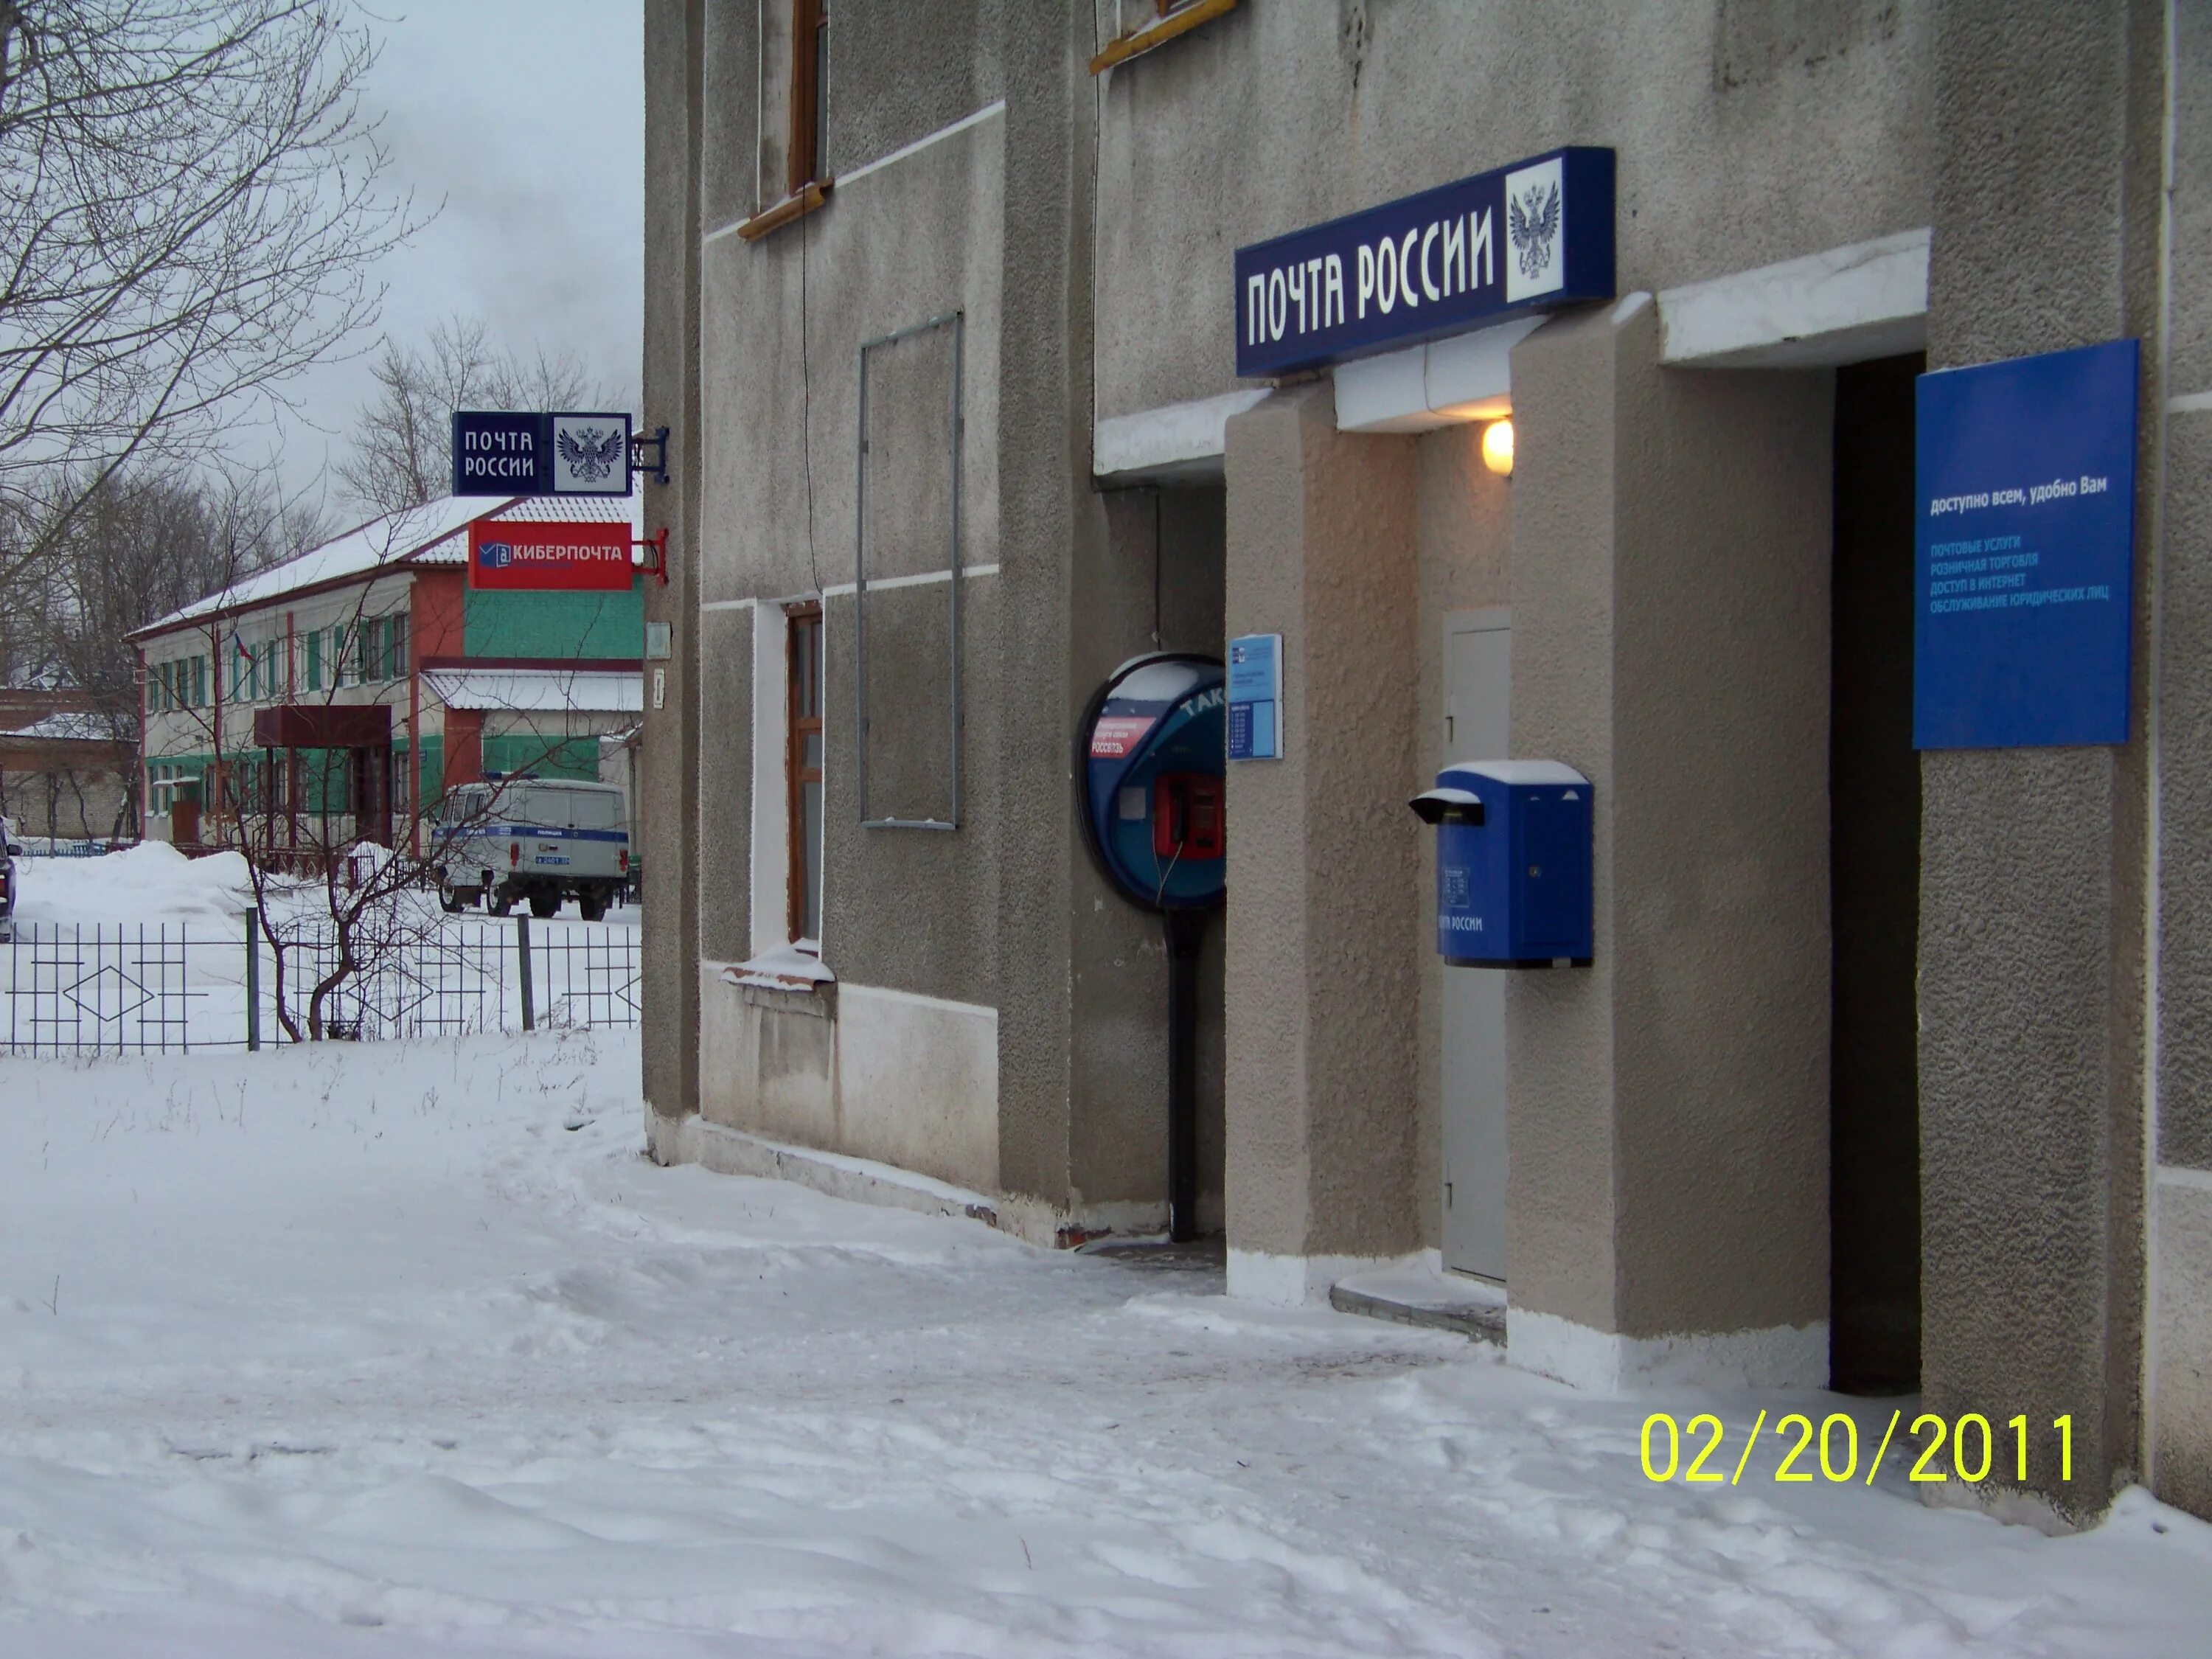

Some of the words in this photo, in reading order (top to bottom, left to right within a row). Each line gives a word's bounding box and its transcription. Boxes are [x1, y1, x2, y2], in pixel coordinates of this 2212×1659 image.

[1248, 254, 1344, 346] ПОЧТА
[1358, 206, 1494, 319] РОССИИ
[465, 431, 532, 451] ПОЧТА
[465, 457, 533, 476] РОССИИ
[1930, 492, 1989, 516] доступно
[1992, 488, 2025, 506] всем,
[2029, 479, 2076, 505] удобно
[2080, 476, 2107, 495] Вам
[513, 545, 622, 561] КИБЕРПОЧТА
[1930, 540, 1982, 557] ПОЧТОВЫЕ
[1984, 536, 2020, 551] УСЛУГИ
[1930, 558, 1986, 576] РОЗНИЧНАЯ
[1989, 553, 2038, 570] ТОРГОВЛЯ
[1930, 578, 1967, 597] ДОСТУП
[1970, 578, 1976, 591] В
[1978, 573, 2026, 590] ИНТЕРНЕТ
[1930, 594, 2008, 613] ОБСЛУЖИВАНИЕ
[2010, 588, 2084, 608] ЮРИДИЧЕСКИХ
[2087, 585, 2109, 601] ЛИЦ
[1452, 916, 1483, 931] РОССИИ
